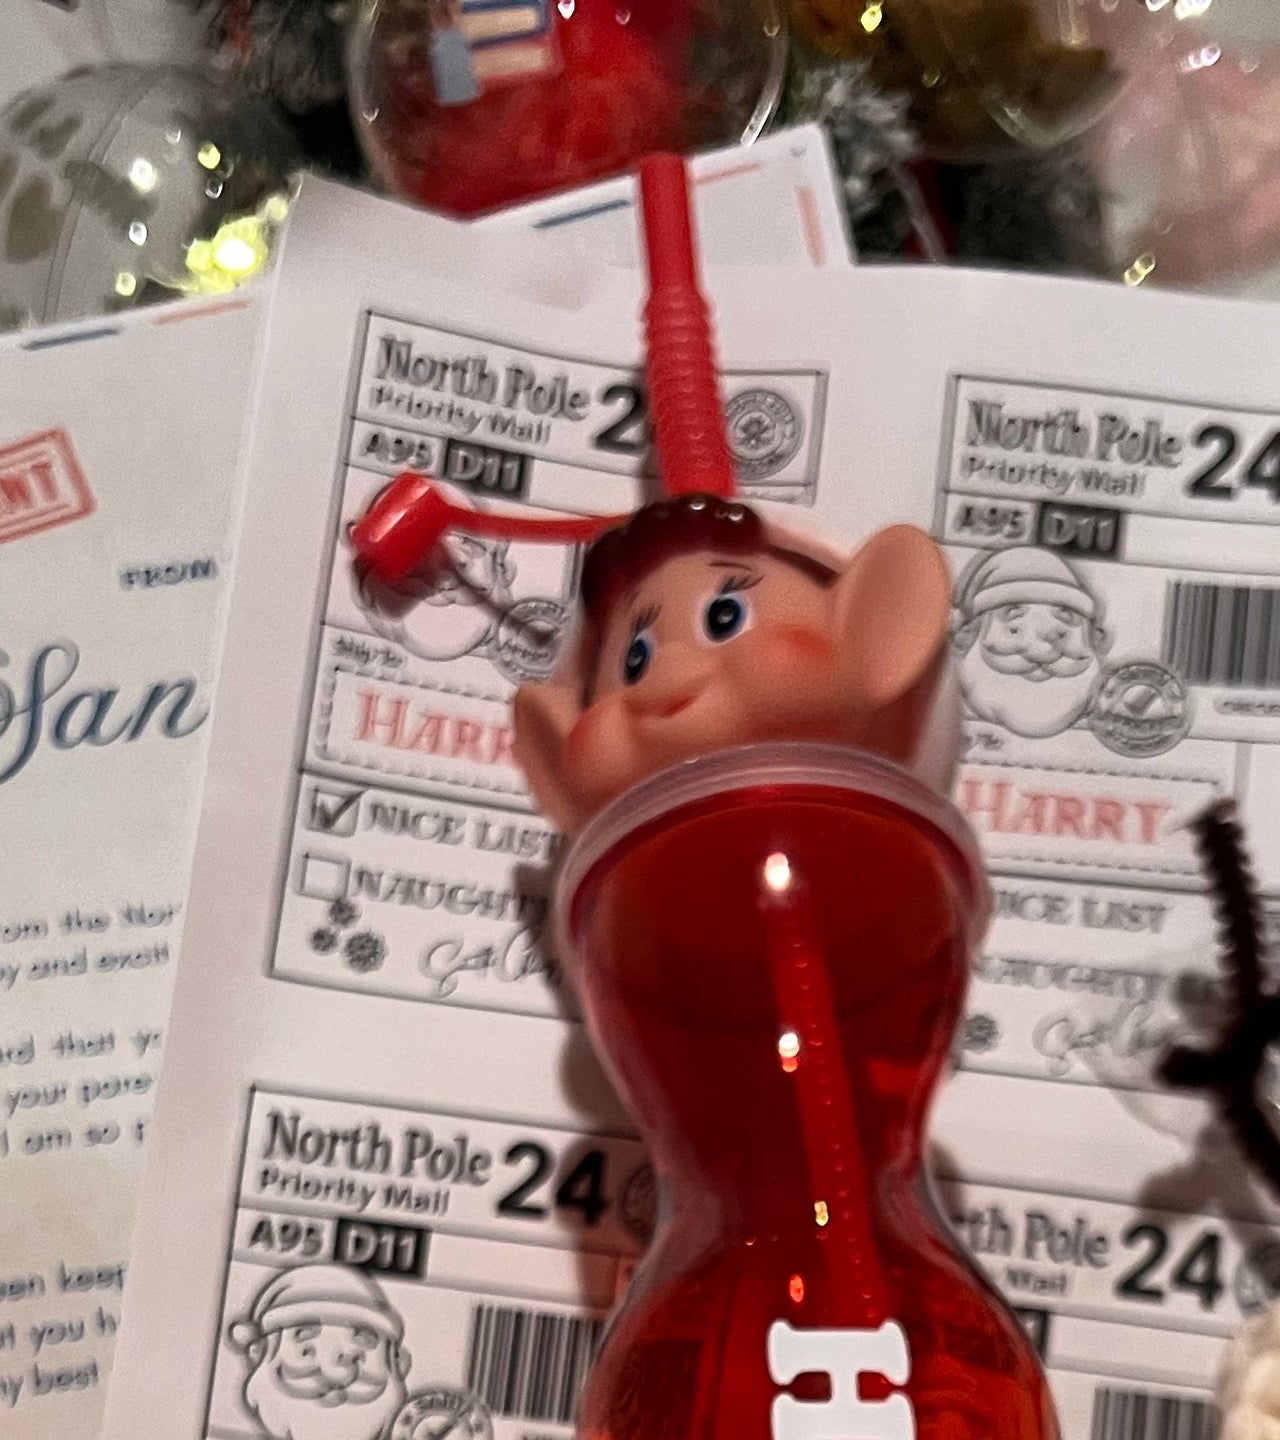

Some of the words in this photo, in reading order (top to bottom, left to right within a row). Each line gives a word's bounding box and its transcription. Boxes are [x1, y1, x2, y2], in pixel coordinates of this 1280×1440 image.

[376, 335, 499, 404] North
[504, 367, 590, 422] Pole
[370, 386, 484, 434] Priority
[485, 411, 553, 444] Mail
[967, 398, 1093, 460] North
[1096, 412, 1183, 470] Pole
[451, 444, 525, 496] D11
[962, 454, 1078, 495] Priority
[1080, 470, 1148, 498] Mail
[1046, 508, 1117, 556] D11
[370, 799, 467, 845] NICE
[474, 822, 562, 862] LIST
[57, 908, 111, 937] the
[1080, 893, 1166, 936] LIST
[27, 946, 89, 980] and
[52, 1029, 117, 1060] that
[4, 1082, 68, 1117] your
[24, 1126, 72, 1156] am
[84, 1121, 121, 1148] so
[258, 1166, 377, 1213] Priority
[382, 1186, 452, 1218] Mail
[261, 1109, 394, 1175] North
[396, 1126, 495, 1189] Pole
[495, 1140, 610, 1229] 24
[248, 1216, 327, 1258] A95
[344, 1227, 420, 1272] D11
[1024, 1210, 1110, 1271] Pole
[1116, 1223, 1226, 1309] 24
[30, 1317, 86, 1357] you
[30, 1359, 99, 1397] best
